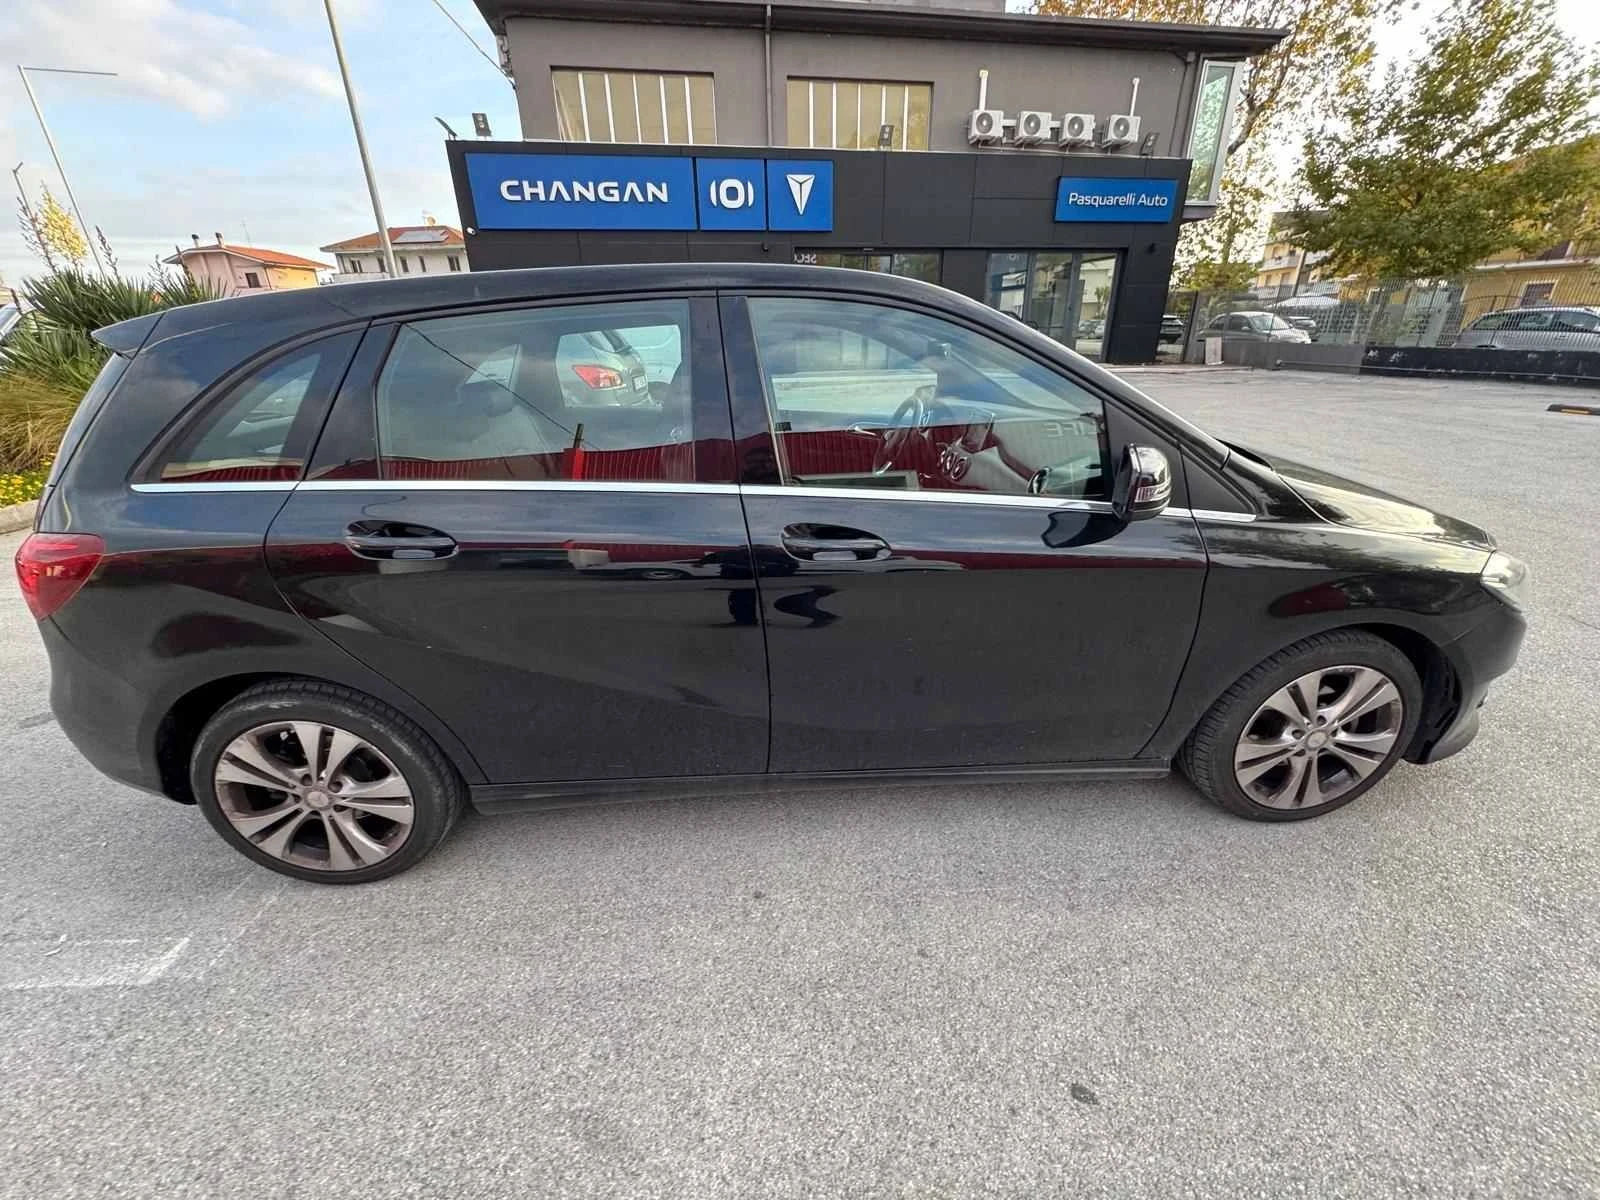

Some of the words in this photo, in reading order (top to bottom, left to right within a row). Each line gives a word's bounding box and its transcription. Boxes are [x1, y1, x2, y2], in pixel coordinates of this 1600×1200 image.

[500, 180, 669, 203] CHANGAN
[1068, 192, 1136, 208] Pasquarelli
[1137, 193, 1168, 206] Auto
